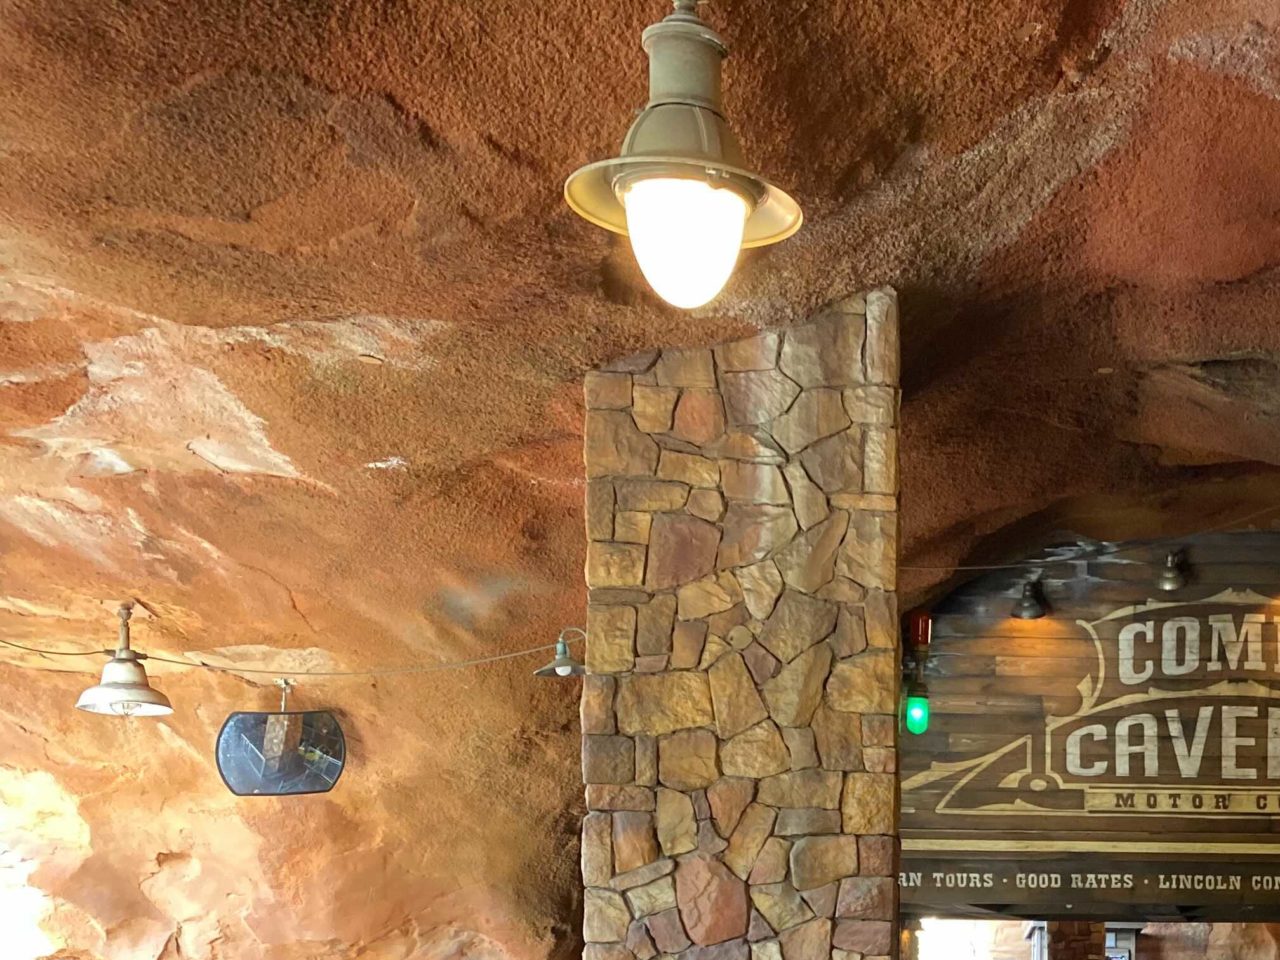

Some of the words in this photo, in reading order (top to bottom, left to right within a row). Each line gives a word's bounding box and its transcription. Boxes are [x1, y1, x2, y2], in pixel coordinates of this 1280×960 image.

[1114, 792, 1230, 811] MOTOR
[932, 872, 994, 888] TOURS
[1015, 873, 1062, 889] GOOD
[1070, 873, 1134, 889] RATES
[1158, 874, 1242, 891] LINCOLN
